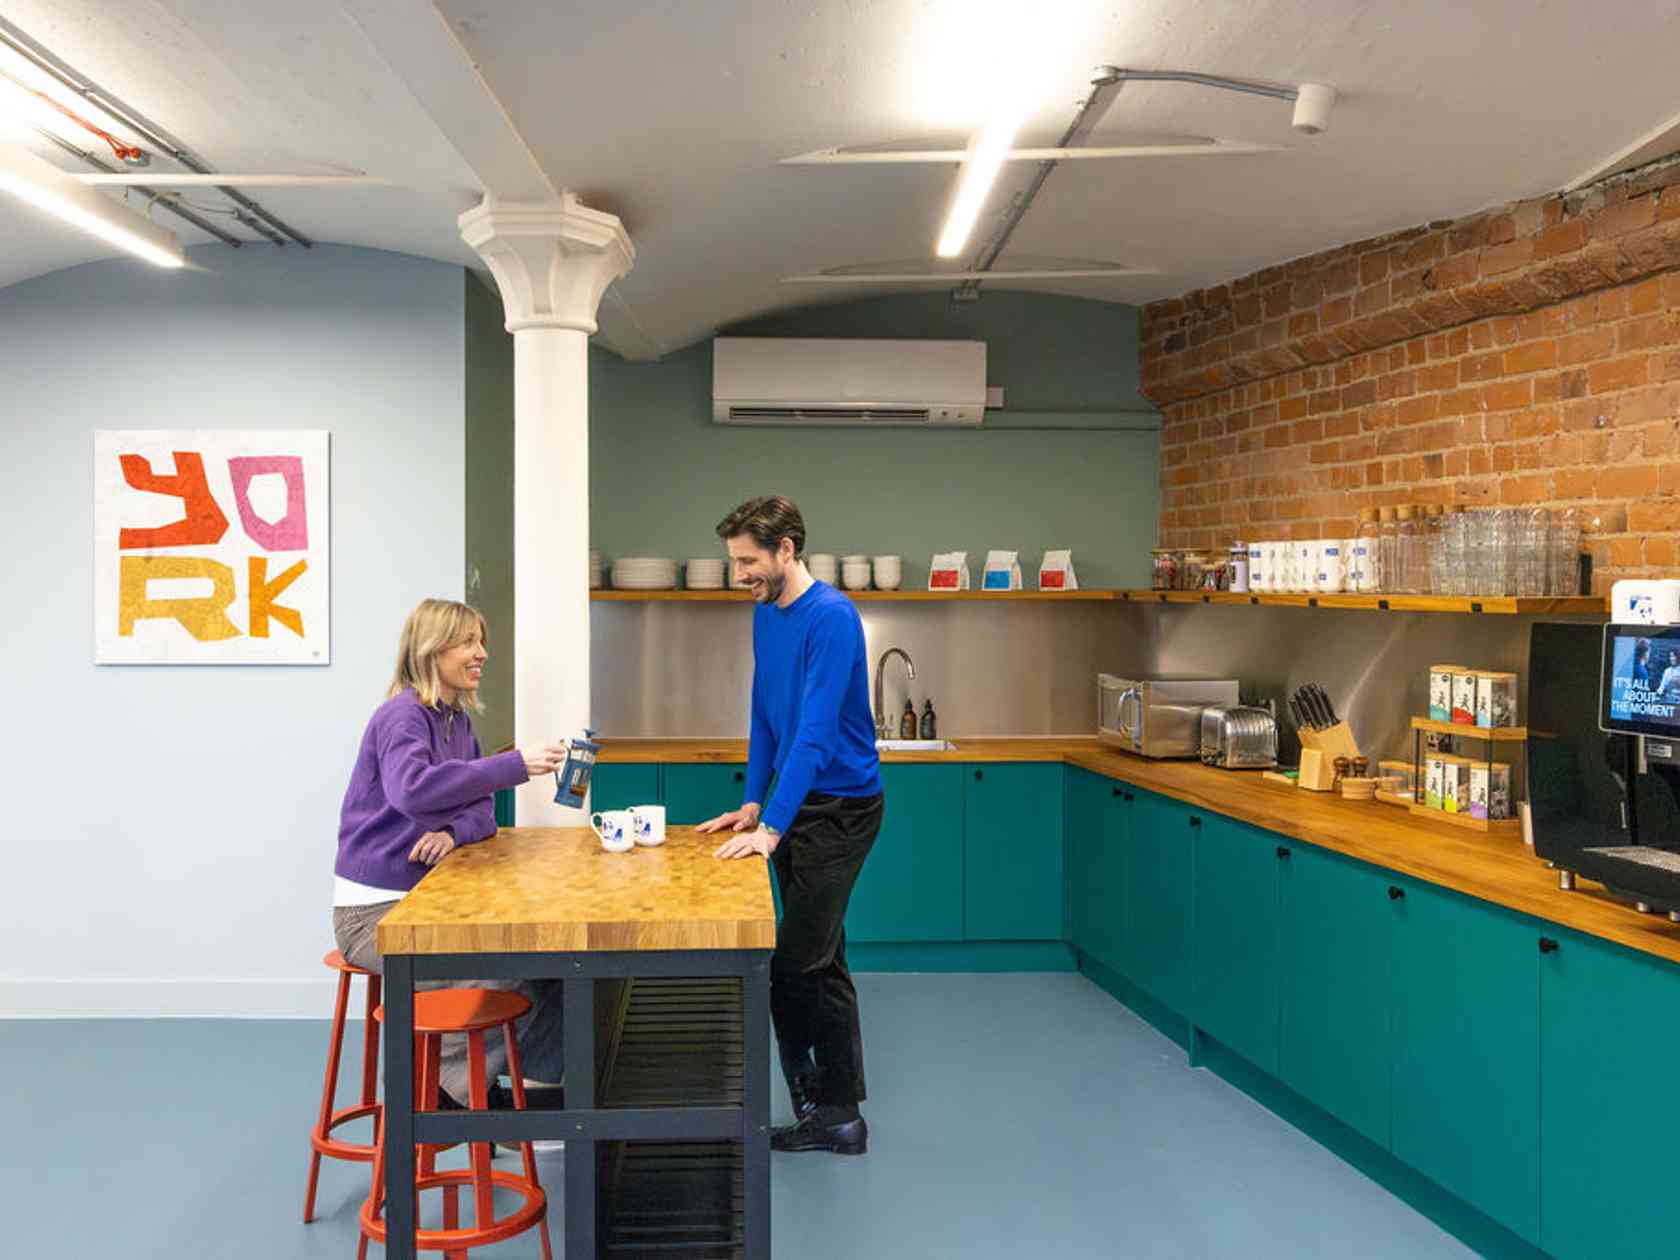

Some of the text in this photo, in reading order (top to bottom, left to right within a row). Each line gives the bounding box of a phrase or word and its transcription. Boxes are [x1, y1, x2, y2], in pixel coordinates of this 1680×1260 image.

[1632, 679, 1649, 690] ALL
[1623, 690, 1655, 702] ABOUT
[1611, 700, 1675, 716] THE MOMENT
